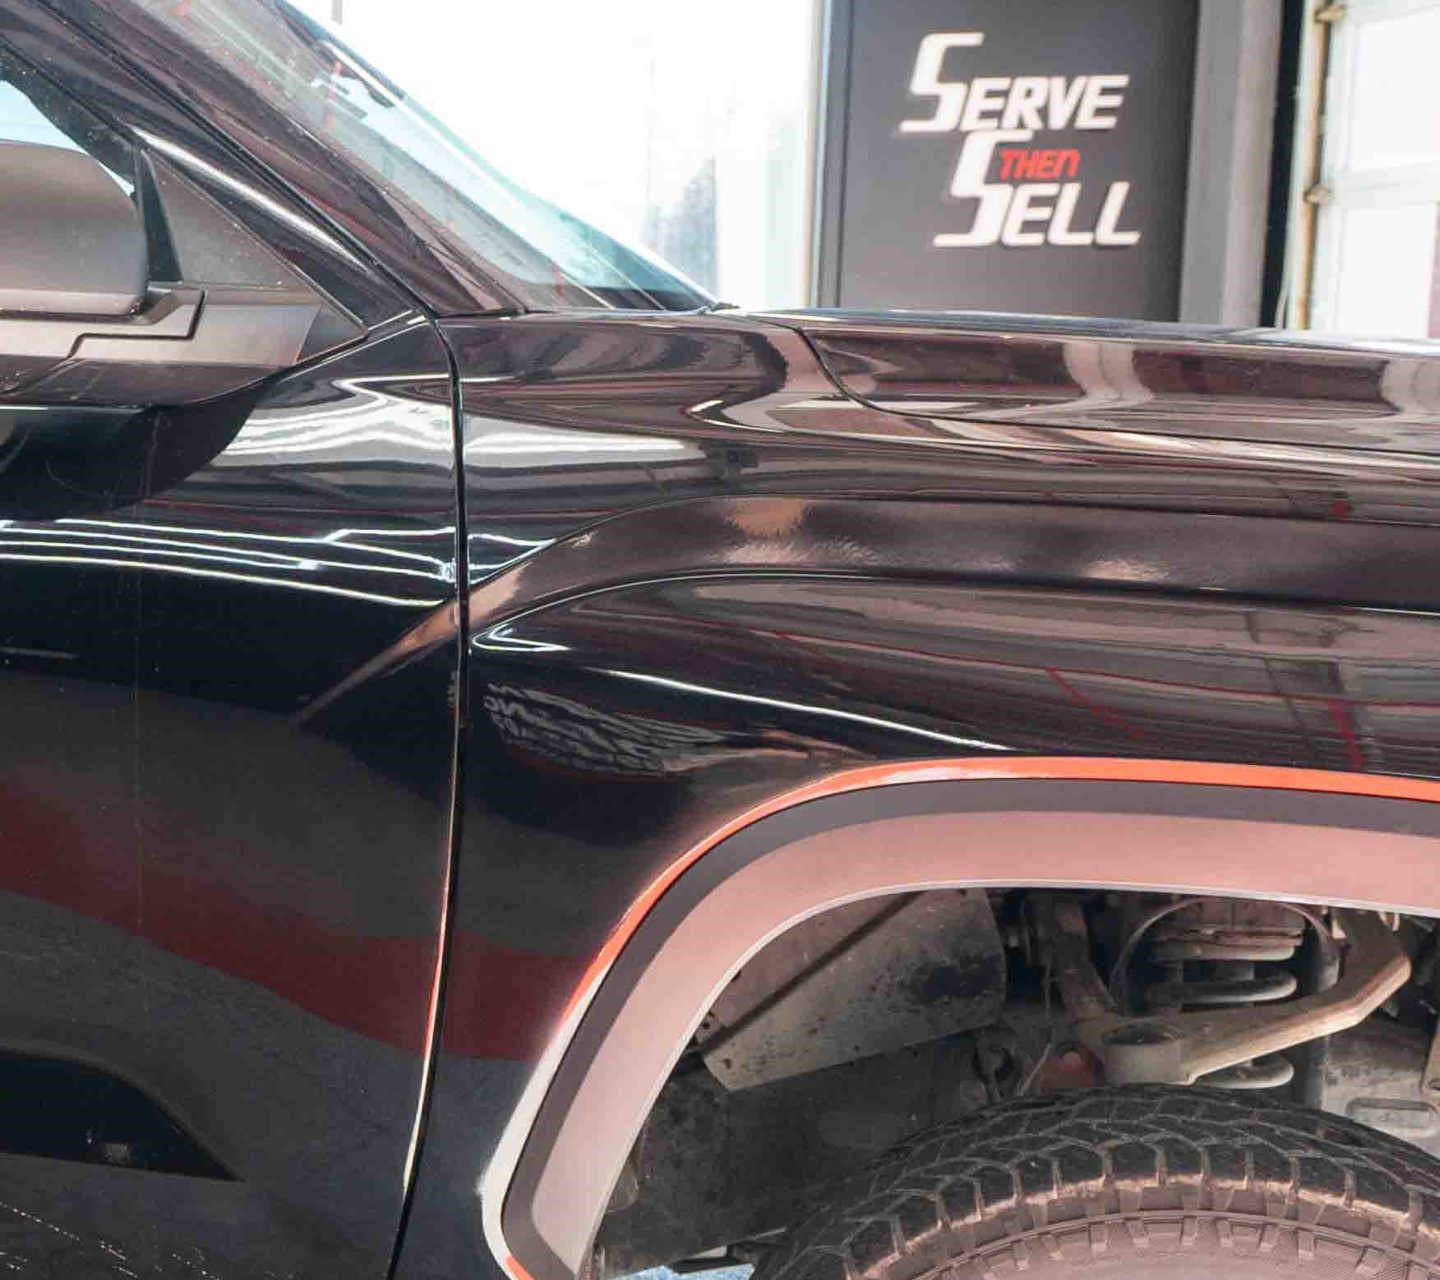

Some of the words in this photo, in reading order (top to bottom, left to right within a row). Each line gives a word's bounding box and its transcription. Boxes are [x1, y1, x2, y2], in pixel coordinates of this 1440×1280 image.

[900, 32, 1130, 132] SERVE
[932, 129, 1141, 247] SELL
[1000, 148, 1080, 179] THEN
